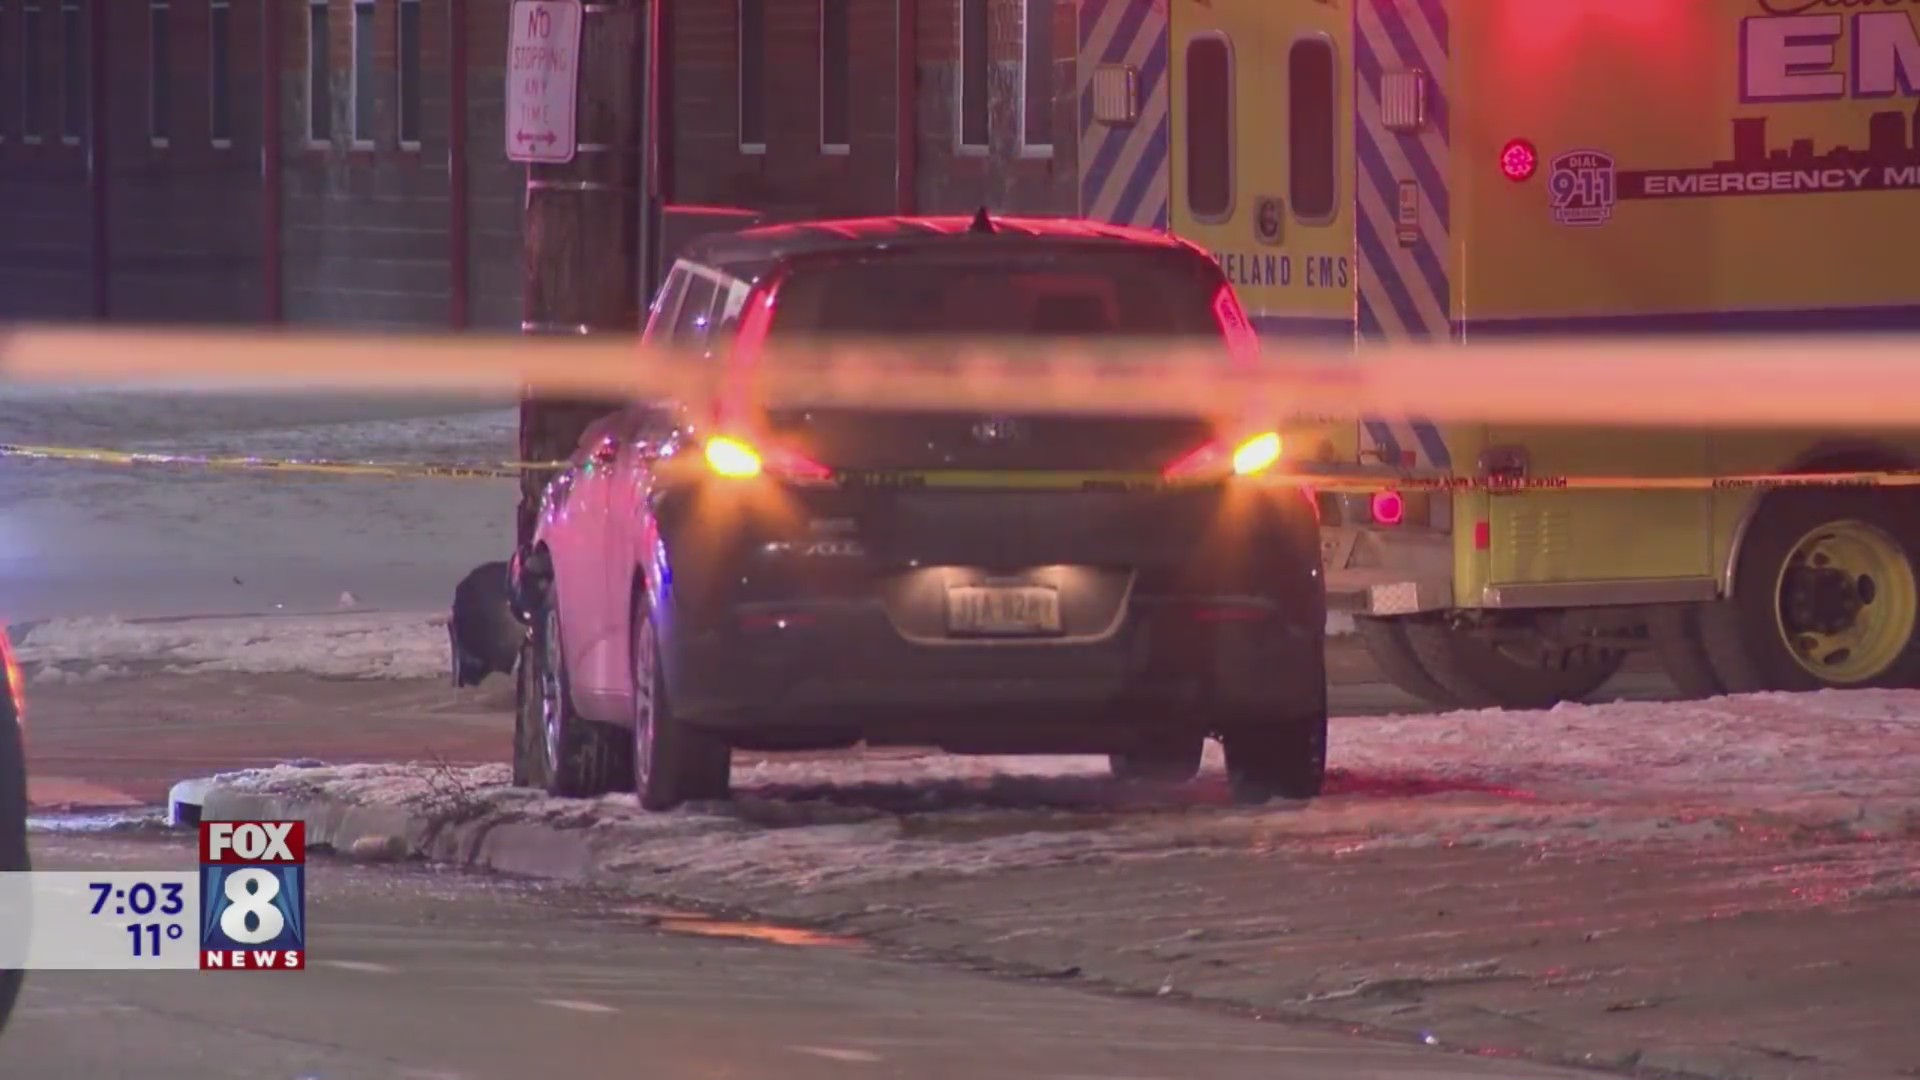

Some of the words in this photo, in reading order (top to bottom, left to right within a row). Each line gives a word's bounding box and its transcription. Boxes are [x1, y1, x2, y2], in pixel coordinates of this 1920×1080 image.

[528, 10, 550, 38] NO
[514, 46, 568, 71] STOPPING
[525, 78, 547, 95] ANY
[522, 103, 549, 125] TIME
[1569, 156, 1598, 169] DIAL
[1549, 168, 1614, 207] 911
[1643, 167, 1869, 194] EMERGENCY
[1883, 165, 1920, 186] M
[1306, 256, 1348, 288] EMS
